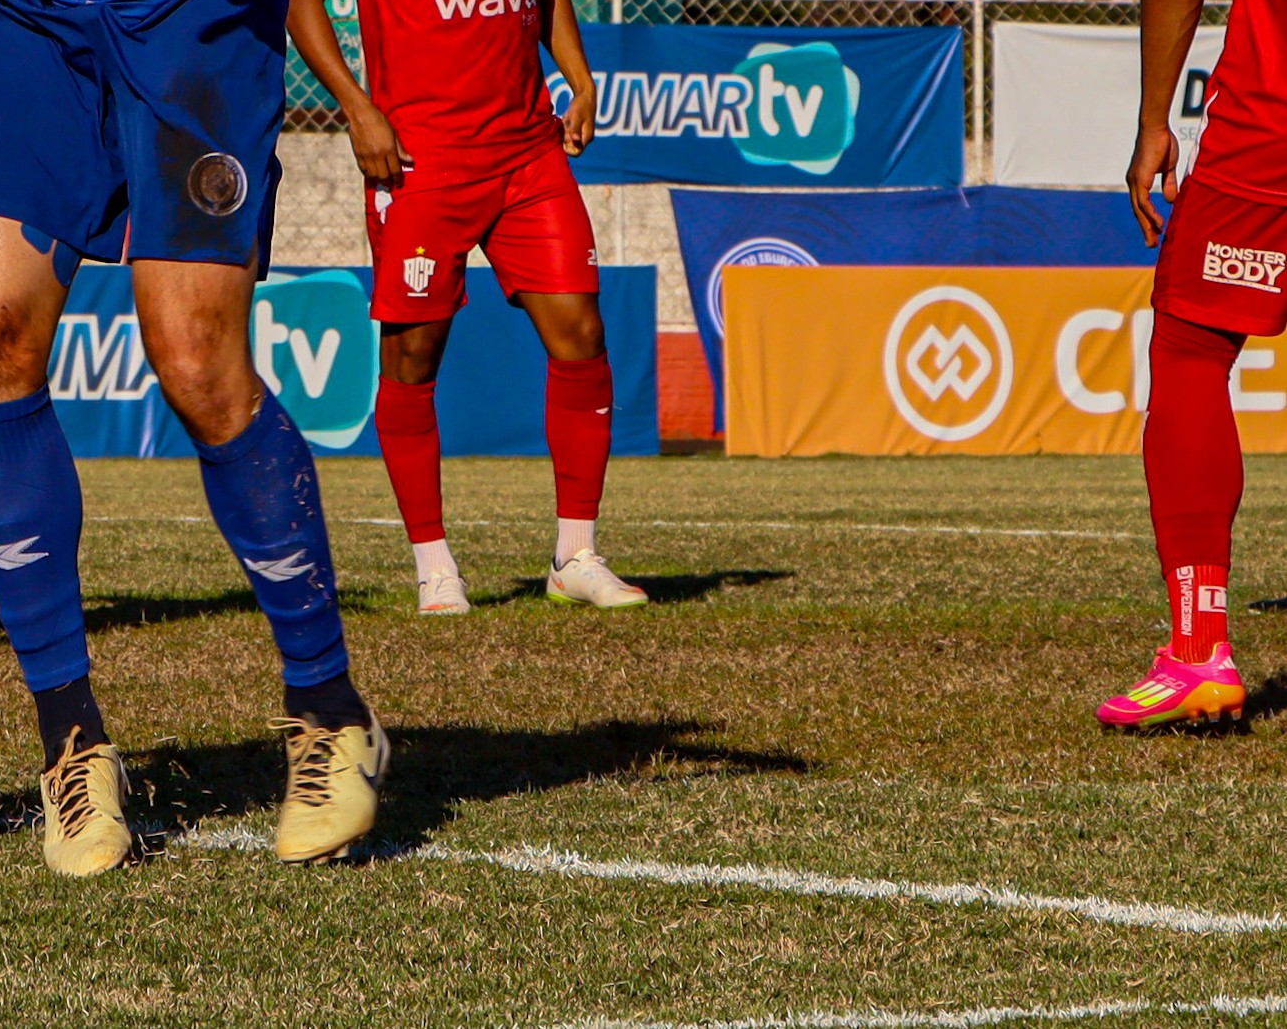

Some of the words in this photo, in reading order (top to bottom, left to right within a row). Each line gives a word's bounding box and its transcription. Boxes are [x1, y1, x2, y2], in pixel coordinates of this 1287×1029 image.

[546, 70, 753, 138] OUMAR
[759, 63, 823, 138] tv
[1203, 253, 1286, 287] BODY
[1206, 240, 1287, 267] MONSTER
